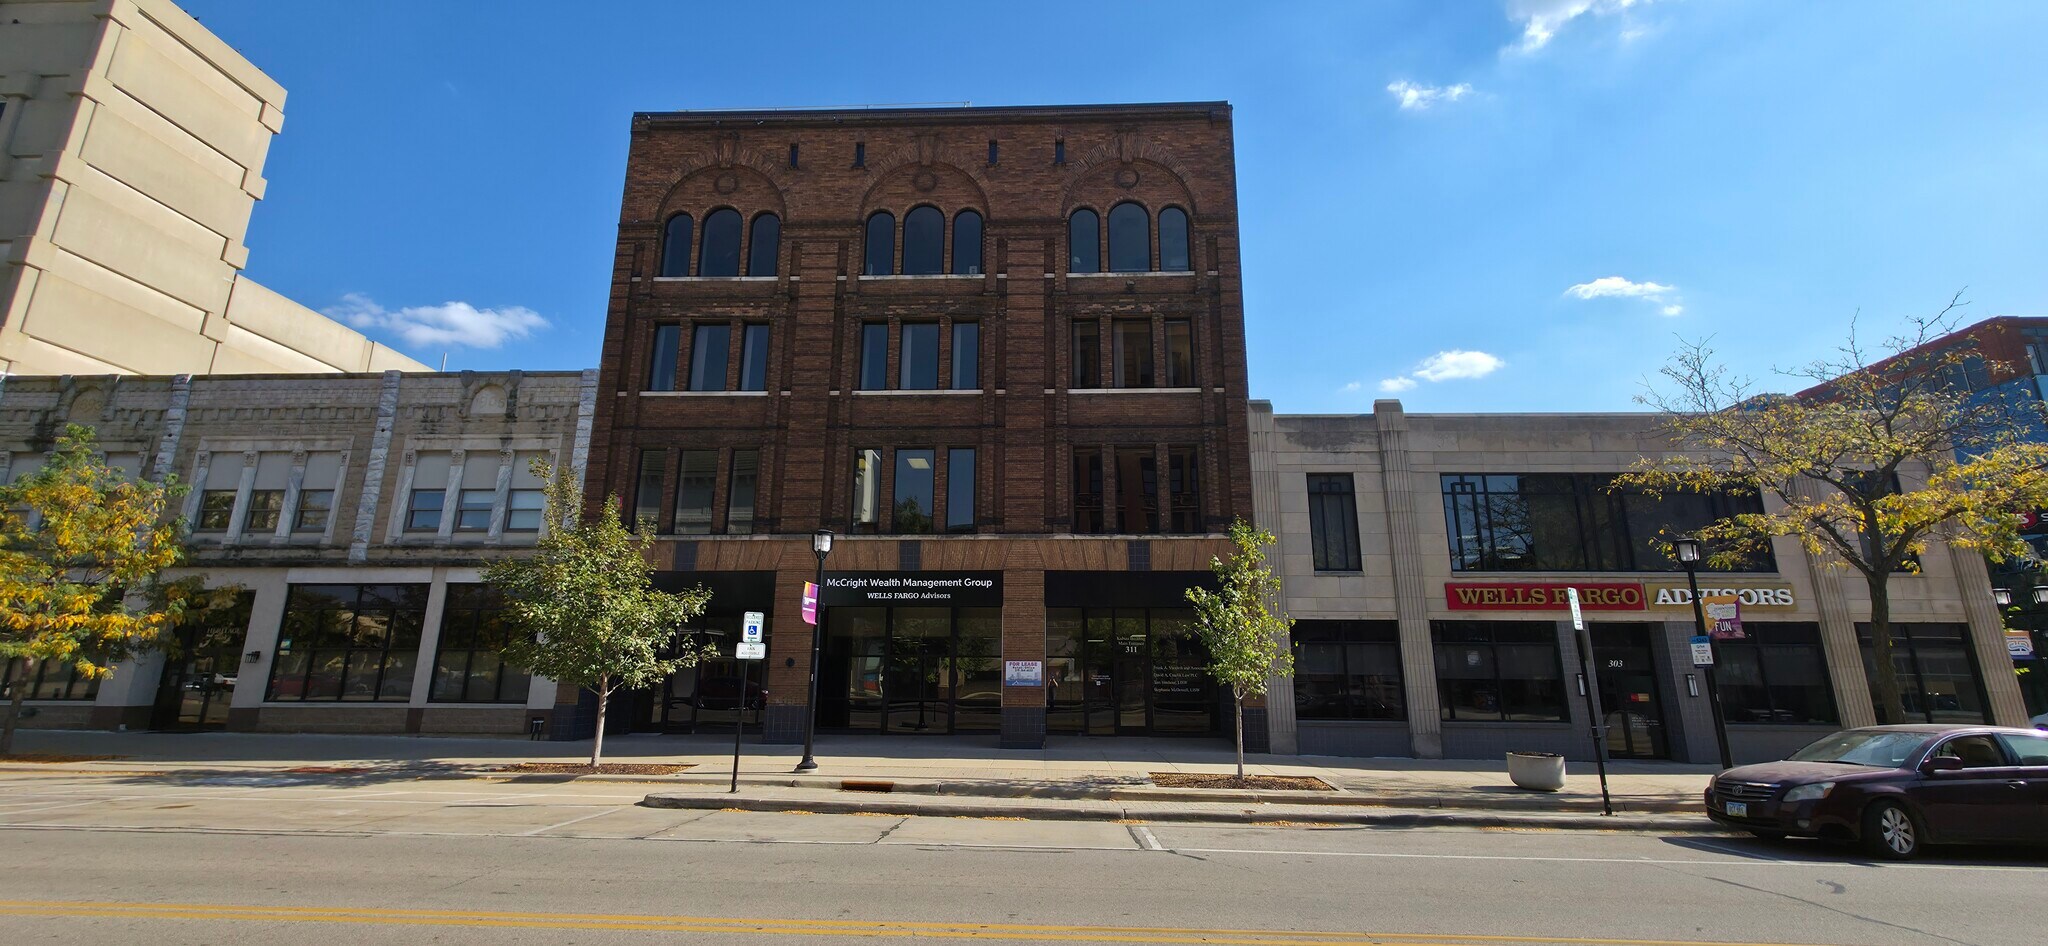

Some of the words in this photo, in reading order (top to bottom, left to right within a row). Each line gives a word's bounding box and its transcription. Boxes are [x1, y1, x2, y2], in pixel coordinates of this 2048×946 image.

[826, 578, 867, 589] McCright
[870, 578, 900, 587] Wealth
[903, 578, 962, 589] Management
[964, 578, 993, 589] Group
[1455, 588, 1548, 605] WELLS
[1551, 588, 1640, 605] FARGO
[1714, 621, 1733, 632] FUN
[1608, 659, 1623, 668] 303
